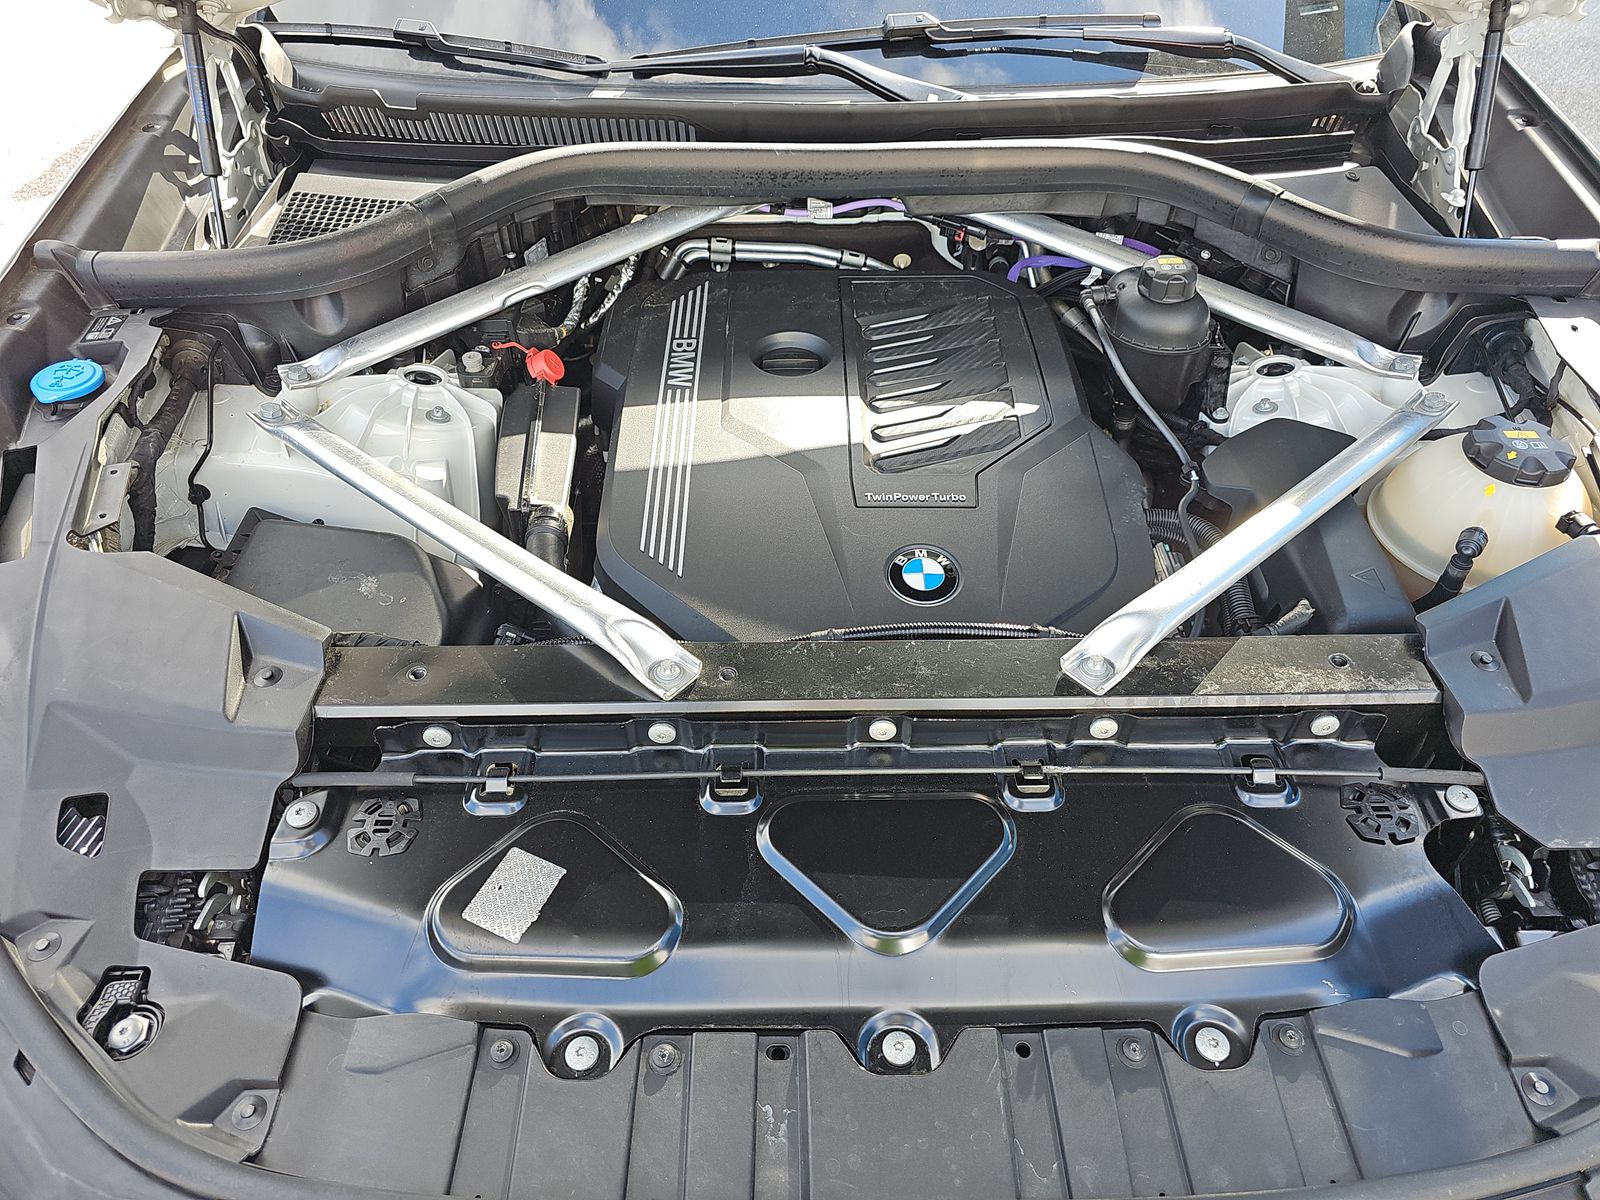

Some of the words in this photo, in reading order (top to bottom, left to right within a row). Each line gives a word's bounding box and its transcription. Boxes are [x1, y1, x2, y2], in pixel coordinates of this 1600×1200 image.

[667, 339, 697, 387] BMW
[864, 492, 930, 502] TwinPower
[931, 492, 967, 502] Turbo
[894, 549, 951, 567] BMW
